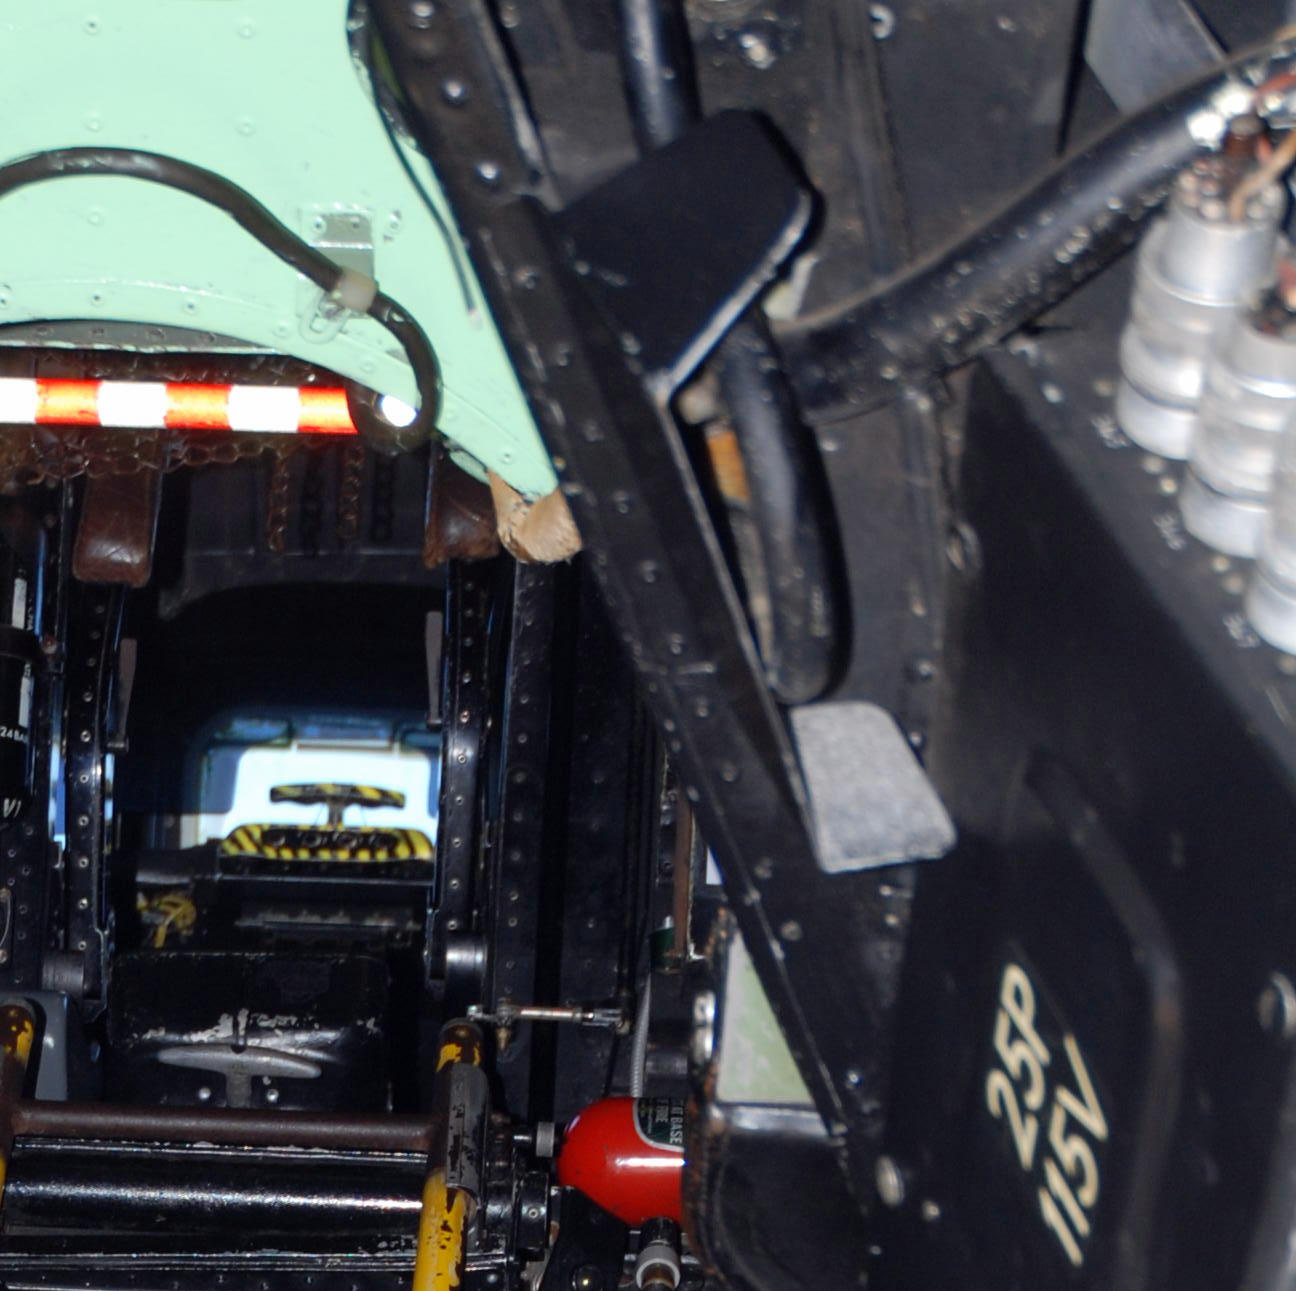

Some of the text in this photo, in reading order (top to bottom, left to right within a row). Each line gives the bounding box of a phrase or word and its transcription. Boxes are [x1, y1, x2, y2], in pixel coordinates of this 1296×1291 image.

[670, 1117, 684, 1144] BASE
[986, 962, 1052, 1170] 25P
[1037, 1034, 1108, 1268] 115V
